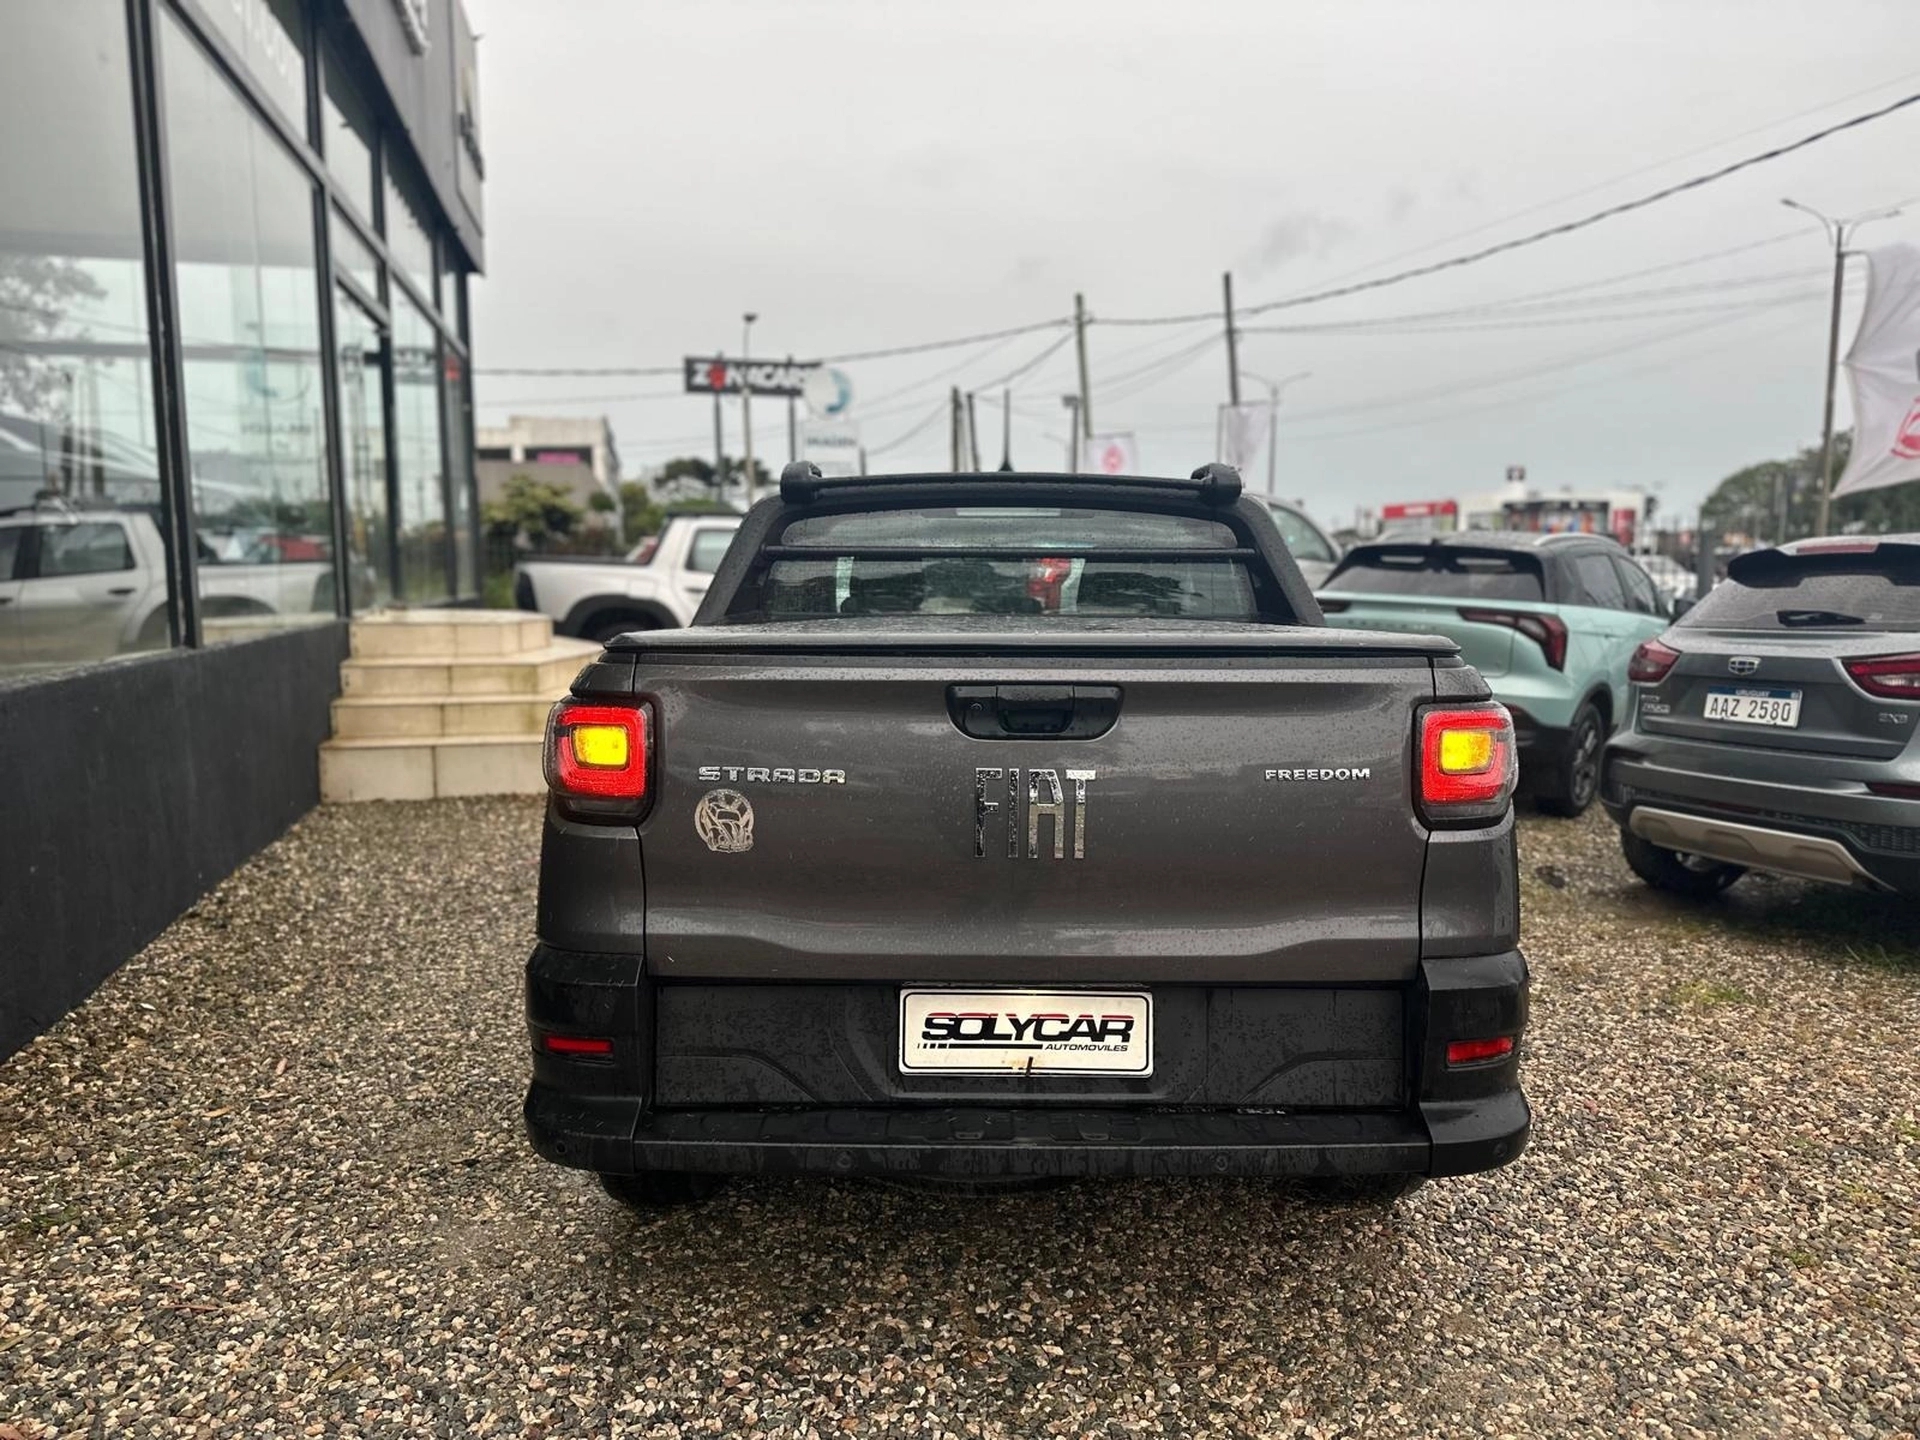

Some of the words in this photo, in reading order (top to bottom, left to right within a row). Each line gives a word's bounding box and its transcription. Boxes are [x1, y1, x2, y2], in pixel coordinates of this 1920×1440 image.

[1710, 697, 1740, 717] AAZ
[1747, 700, 1792, 722] 2580
[698, 766, 846, 784] STRADA
[1264, 768, 1371, 781] FREEDOM
[975, 768, 1097, 859] FIAT
[921, 1012, 1135, 1043] SOLYCAR
[1044, 1043, 1129, 1052] AUTOMOVILES
